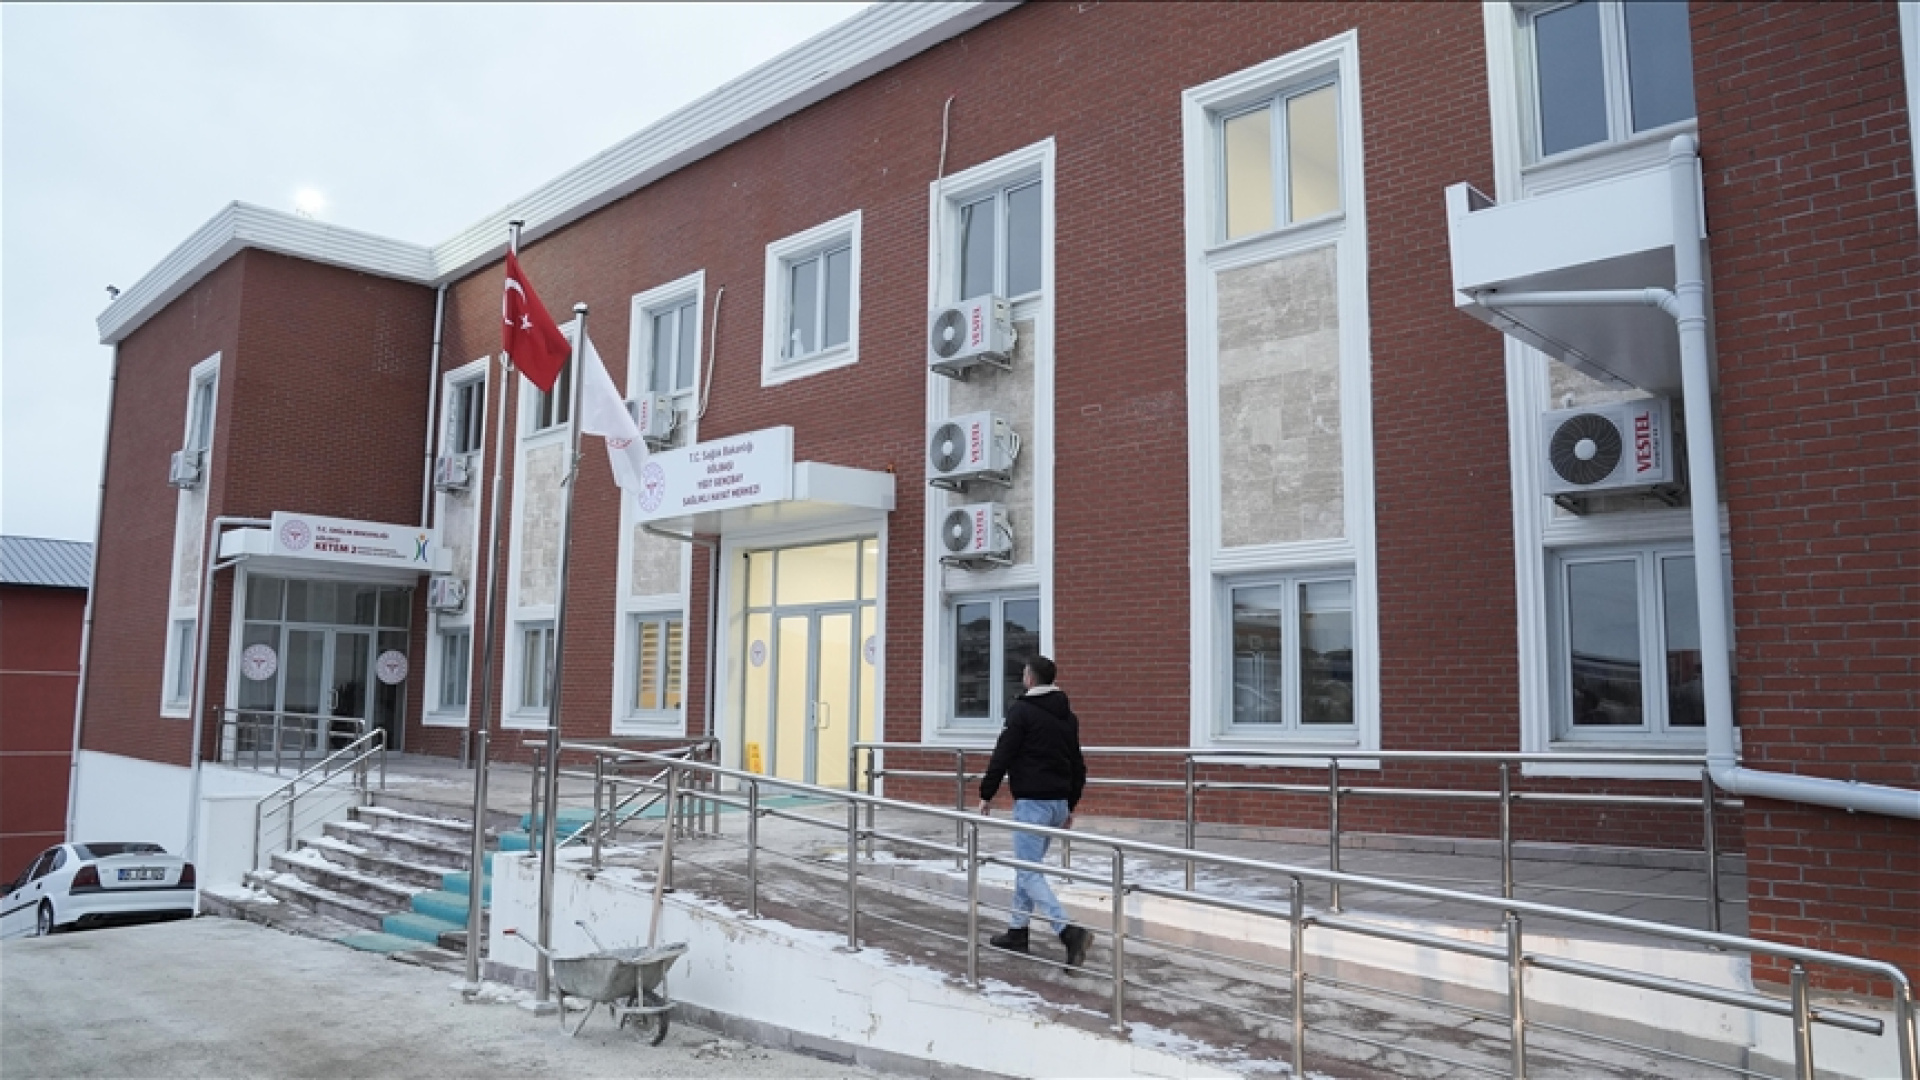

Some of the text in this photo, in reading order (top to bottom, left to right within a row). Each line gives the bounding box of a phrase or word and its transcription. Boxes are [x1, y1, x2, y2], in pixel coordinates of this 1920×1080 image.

[972, 304, 981, 347] VESTEL
[971, 421, 980, 464] VESTEL
[1635, 411, 1651, 473] VESTEL
[315, 542, 349, 552] KETEM
